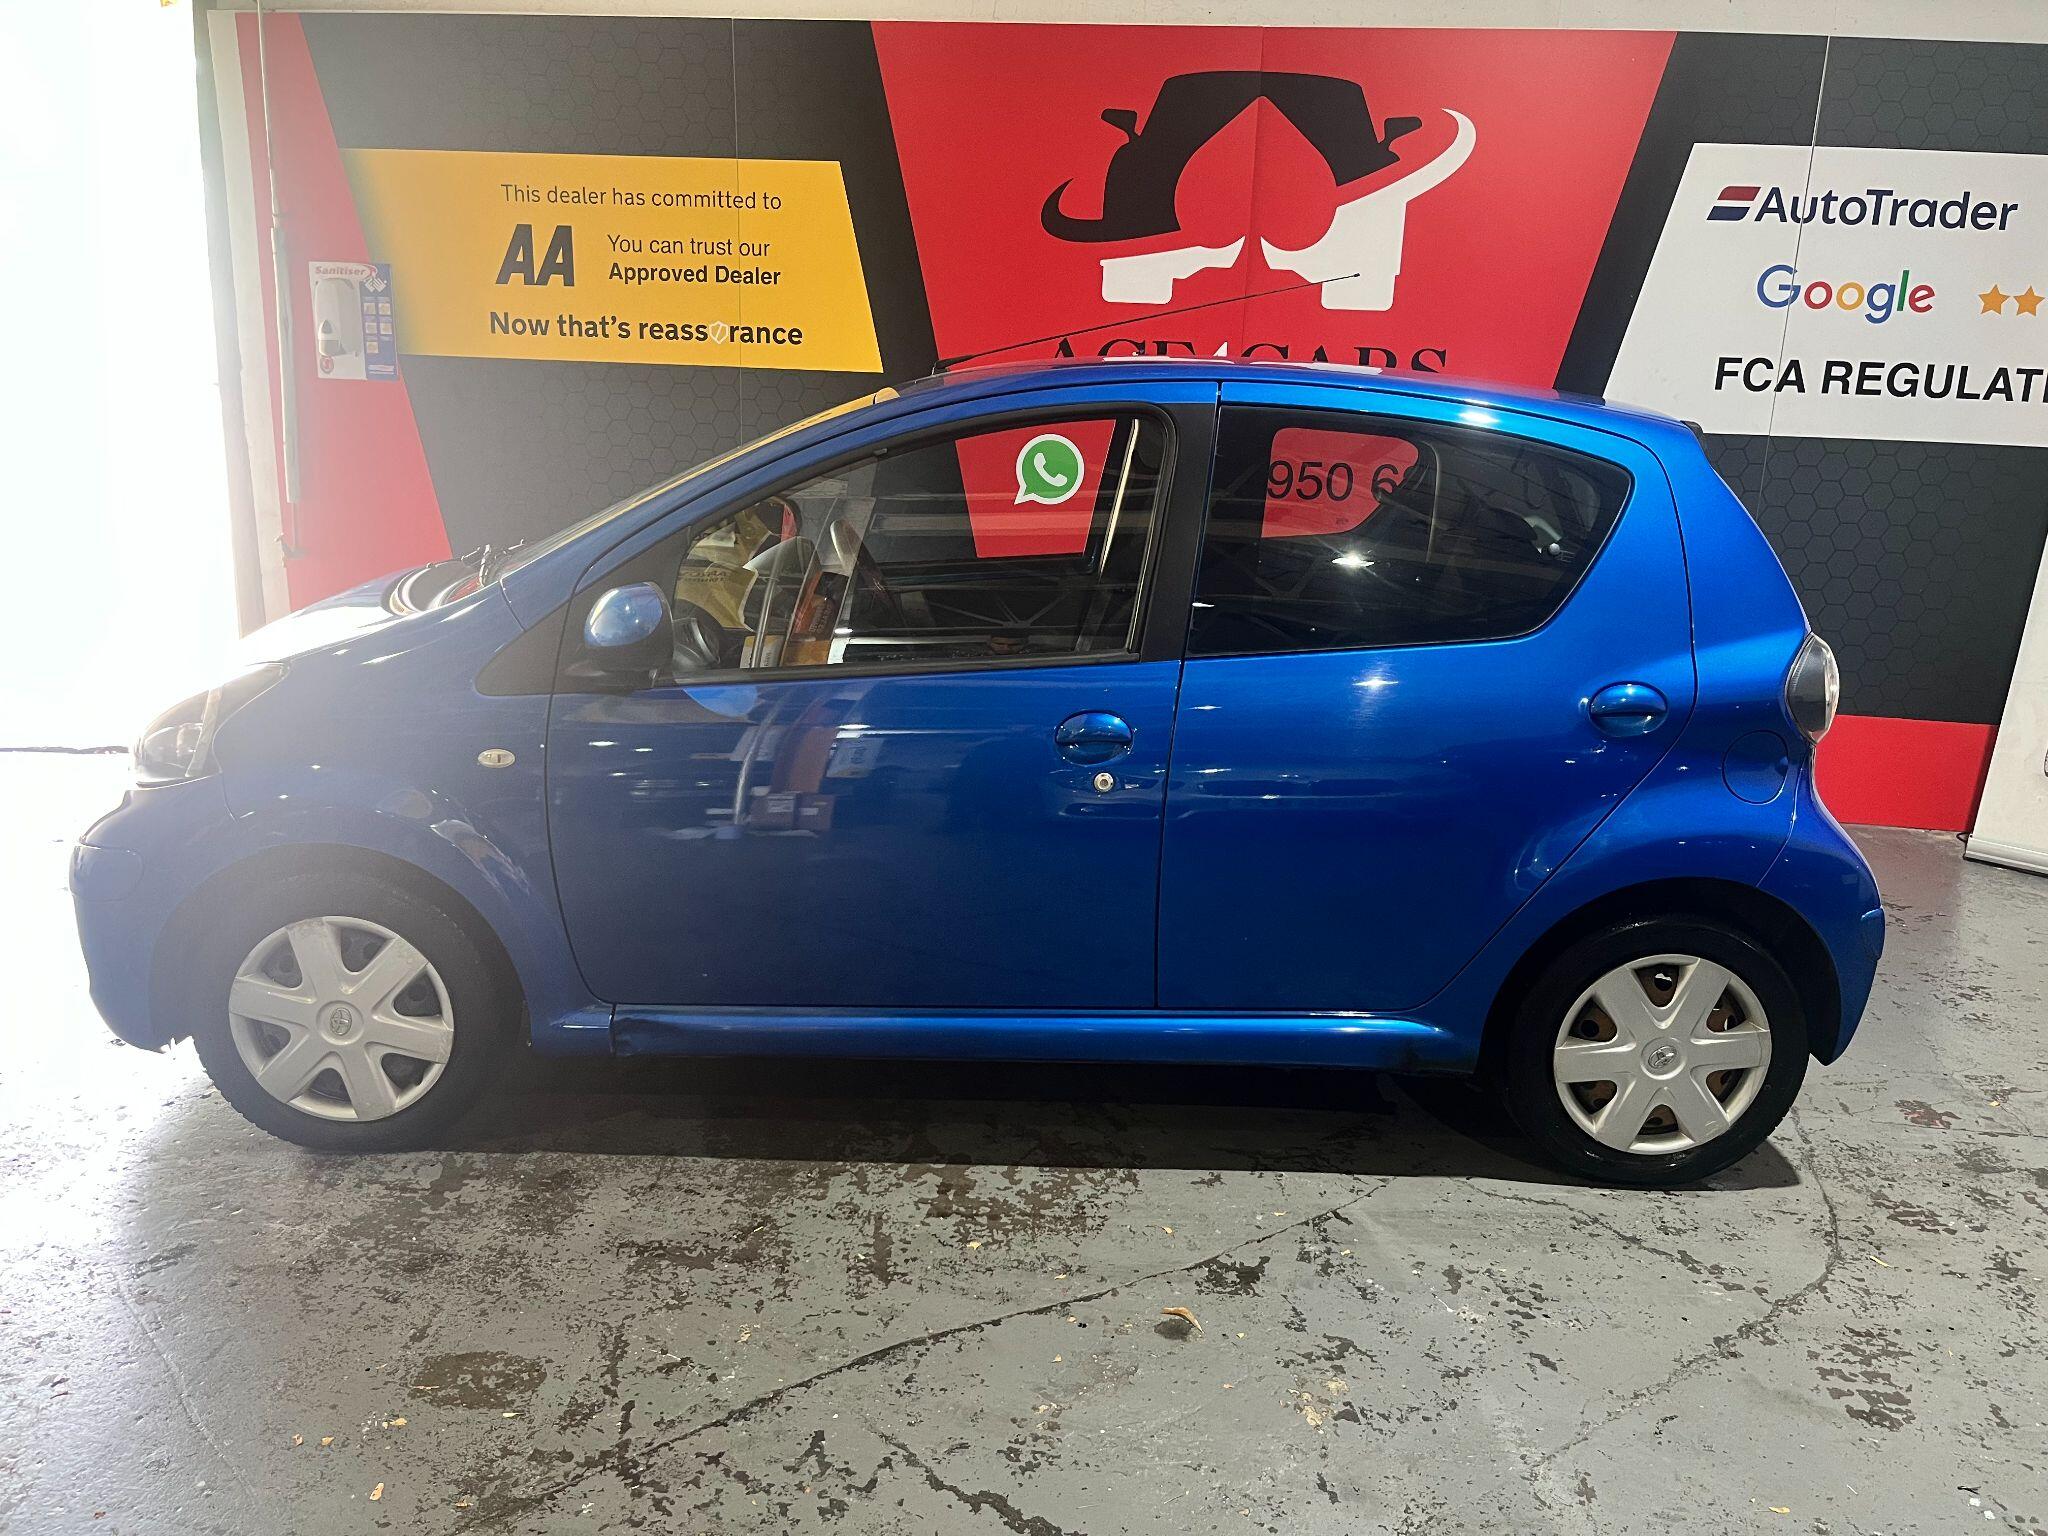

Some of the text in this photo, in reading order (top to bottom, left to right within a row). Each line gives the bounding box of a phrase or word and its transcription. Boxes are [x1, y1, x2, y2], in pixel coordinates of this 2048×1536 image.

[501, 183, 782, 210] This dealer has committed to
[1754, 186, 2019, 231] AutoTrader
[495, 223, 575, 286] AA
[607, 234, 771, 257] You can trust our
[315, 265, 366, 276] Sanitiser
[608, 262, 782, 286] Approved Dealer
[1756, 264, 1936, 324] Google
[489, 311, 549, 336] Now
[1714, 357, 2048, 404] FCA REGULAT
[1267, 460, 1353, 501] 950
